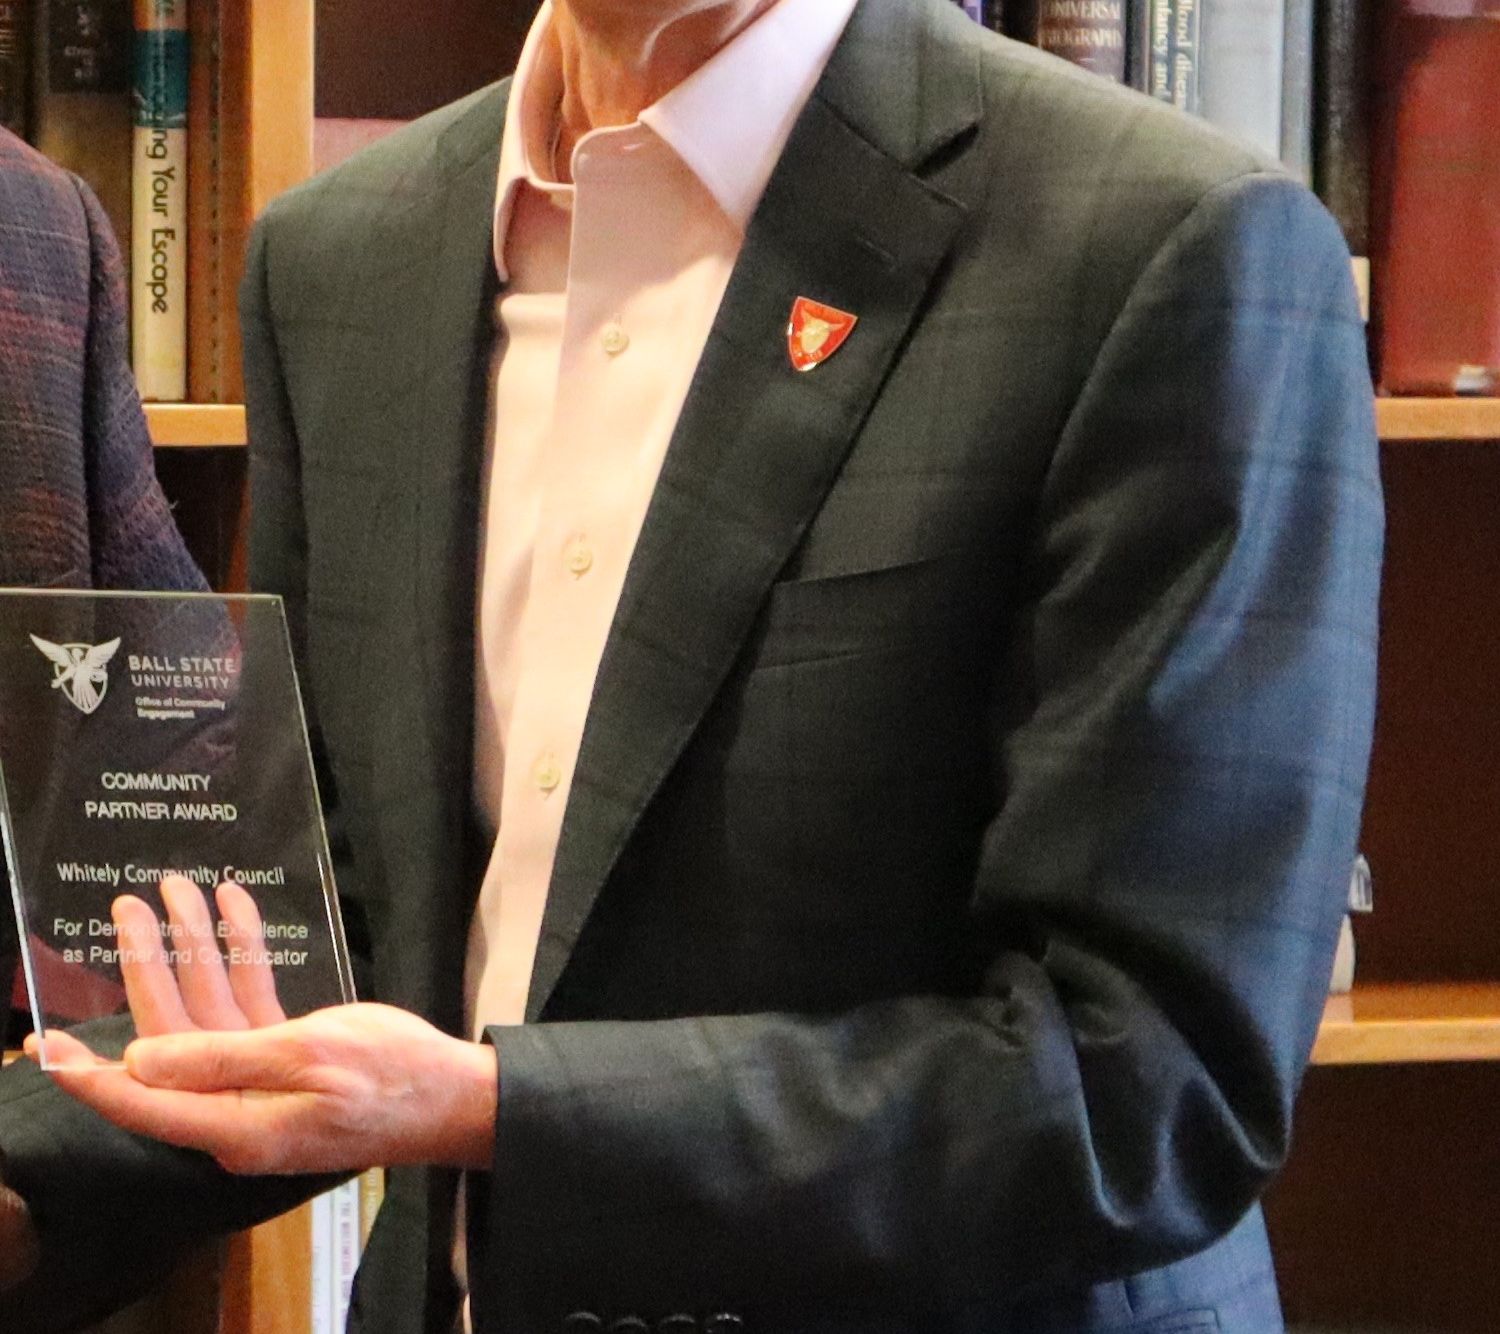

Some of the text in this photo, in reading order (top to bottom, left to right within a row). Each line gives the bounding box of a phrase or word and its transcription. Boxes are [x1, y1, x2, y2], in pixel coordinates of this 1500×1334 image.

[146, 166, 178, 314] Your Escape
[127, 652, 237, 674] BALL STATE
[130, 674, 232, 690] UNIVERSITY
[134, 696, 227, 711] Office Community
[136, 707, 197, 722] Engagement
[100, 771, 212, 793] COMMUNITY
[84, 800, 239, 823] PARTNER AWARD
[57, 862, 286, 887] Whitely Community Council
[53, 917, 310, 941] For Demonstrated Excellence
[63, 946, 310, 968] as Partner and Co-Educator
